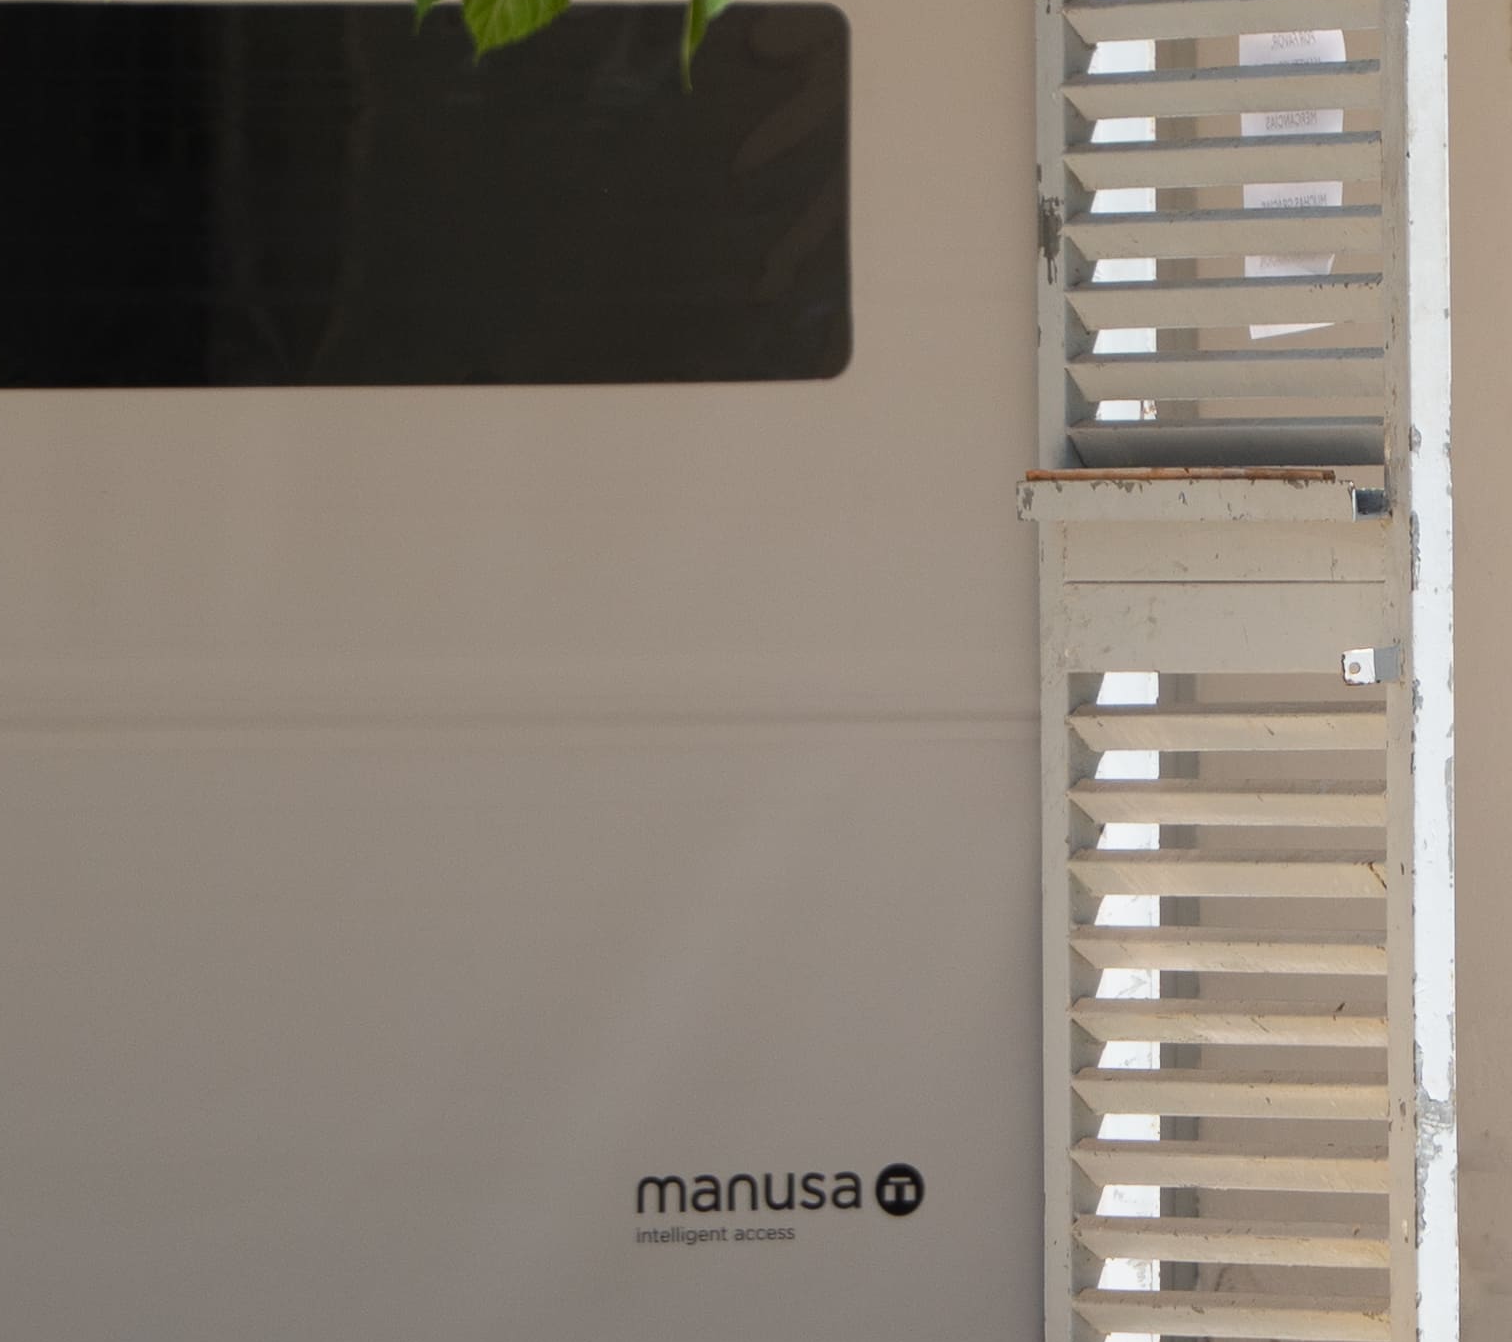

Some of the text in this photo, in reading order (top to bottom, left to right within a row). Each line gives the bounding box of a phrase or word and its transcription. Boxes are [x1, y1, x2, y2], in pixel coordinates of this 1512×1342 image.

[637, 1171, 862, 1213] manusa
[636, 1226, 796, 1245] intelligent access
